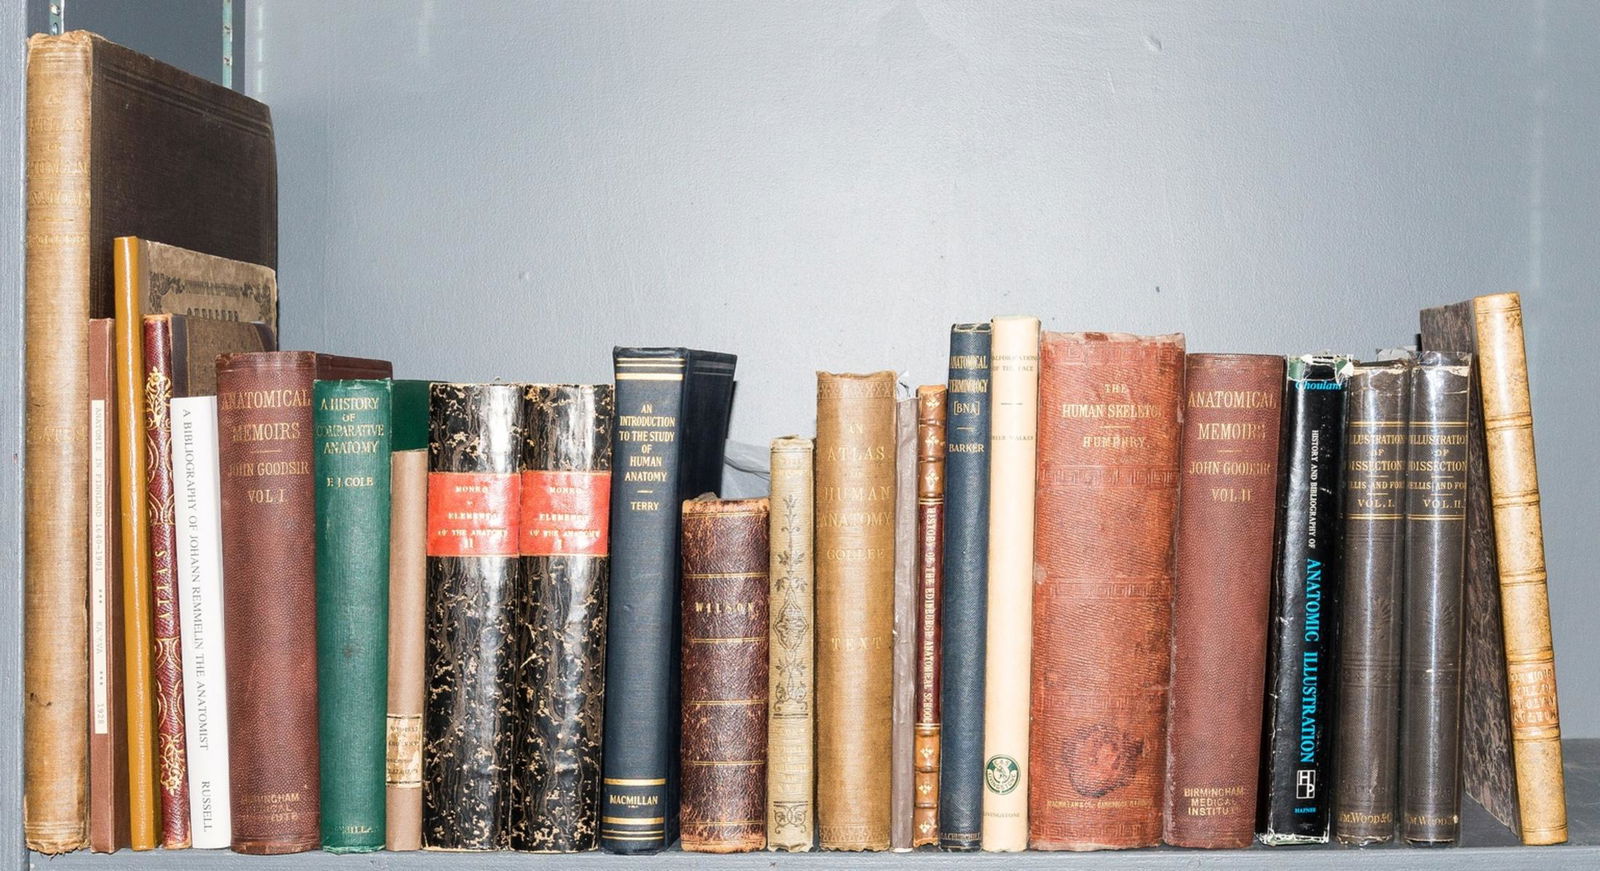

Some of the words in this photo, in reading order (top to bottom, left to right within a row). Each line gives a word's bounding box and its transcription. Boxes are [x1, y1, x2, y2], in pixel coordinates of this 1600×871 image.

[1104, 384, 1128, 394] THE
[220, 390, 311, 410] ANATOMICAL
[320, 400, 329, 410] A
[330, 398, 380, 410] HISTORY
[1188, 390, 1277, 408] ANATOMICAL
[182, 409, 191, 418] A
[641, 404, 652, 414] AN
[954, 400, 980, 415] [BNA]
[1062, 404, 1105, 418] HUMAN
[342, 414, 356, 422] OF
[620, 416, 676, 427] INTRODUCTION
[232, 423, 300, 442] MEMOIRS
[316, 424, 384, 438] COMPARATIVE
[619, 431, 630, 440] TO
[632, 431, 648, 442] THE
[650, 431, 675, 442] STUDY
[1198, 423, 1266, 440] MEMOIRS
[324, 441, 380, 454] ANATOMY
[642, 444, 652, 454] OF
[827, 446, 886, 460] ATLAS
[949, 444, 984, 453] BARKER
[1311, 430, 1319, 462] HISTORY
[96, 458, 102, 469] IN
[183, 422, 196, 510] BIBLIOGRAPHY
[630, 456, 662, 467] HUMAN
[257, 462, 310, 476] GOODSIR
[1190, 462, 1220, 475] JOHN
[1223, 462, 1272, 476] GOODSIR
[1310, 464, 1318, 480] AND
[344, 478, 374, 487] COLE
[624, 472, 668, 482] ANATOMY
[824, 486, 891, 500] HUMAN
[1372, 482, 1388, 490] AND
[1409, 482, 1432, 490] ELLIS
[1436, 482, 1452, 490] AND
[630, 502, 660, 510] TERRY
[1308, 482, 1318, 536] BIBLIOGRAPHY
[1358, 499, 1386, 508] VOL.
[1423, 500, 1453, 509] VOL.
[188, 516, 198, 531] OF
[820, 512, 892, 528] ANATOMY
[926, 508, 936, 546] HISTORY
[1308, 538, 1316, 549] OF
[190, 534, 200, 583] JOHANN
[926, 552, 935, 562] OF
[925, 566, 935, 585] THE
[154, 550, 171, 620] ATLAS
[1304, 558, 1321, 642] ANATOMIC
[695, 602, 755, 616] WILSON
[924, 588, 935, 636] EDINBURGH
[192, 586, 204, 650] REMMELIN
[831, 636, 882, 652] TEXT
[196, 654, 206, 678] THE
[924, 640, 934, 689] ANATOMICAL
[923, 692, 933, 723] SCHOOL
[1300, 652, 1318, 762] ILLUSTRATION
[196, 681, 208, 751] ANATOMIST
[1184, 786, 1244, 798] BIRMINGHAM
[201, 780, 212, 833] RUSSELL
[610, 794, 658, 806] MACMILLAN
